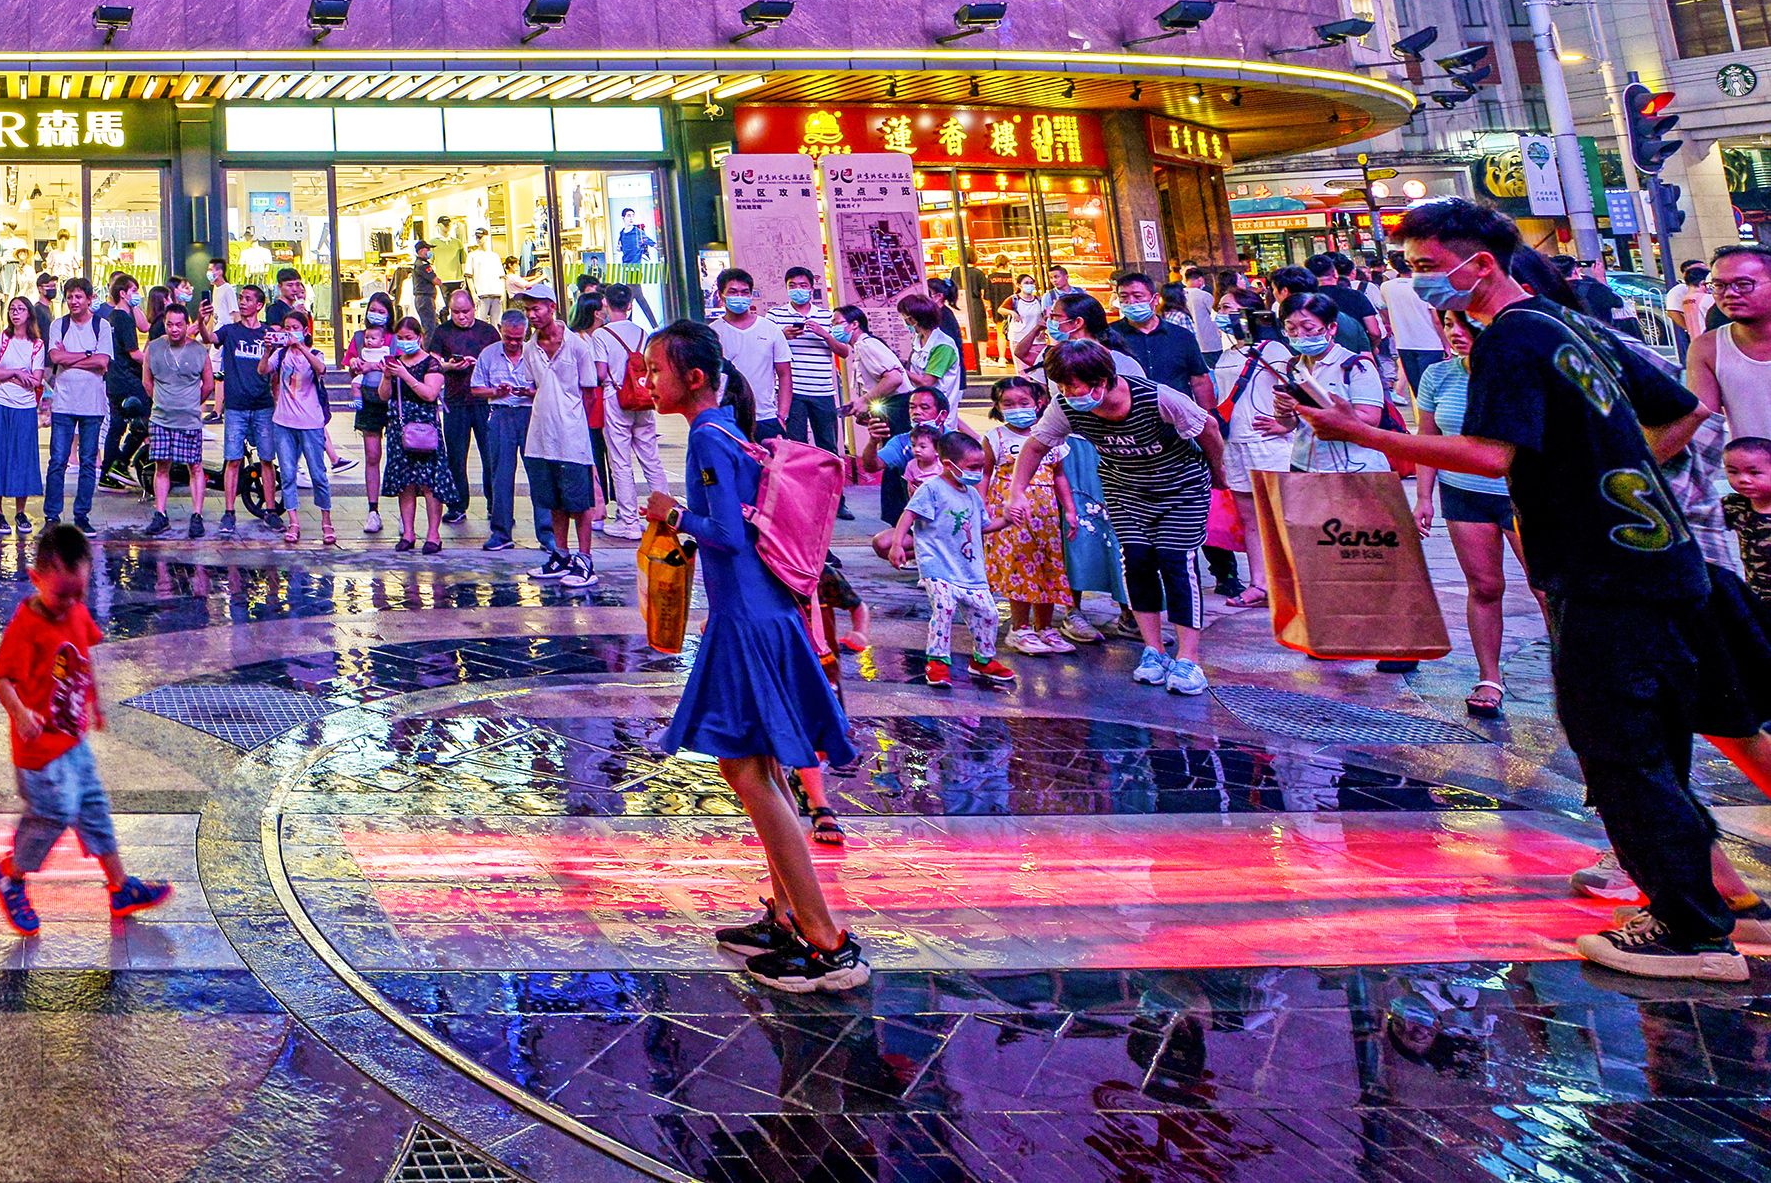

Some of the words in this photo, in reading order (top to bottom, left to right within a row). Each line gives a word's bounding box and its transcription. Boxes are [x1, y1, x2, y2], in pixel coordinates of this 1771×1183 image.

[36, 109, 125, 148] 森馬
[883, 114, 1018, 158] 蓮香樓
[834, 186, 911, 197] 景点导览
[1103, 435, 1137, 446] TAN
[1316, 518, 1400, 548] Sanse
